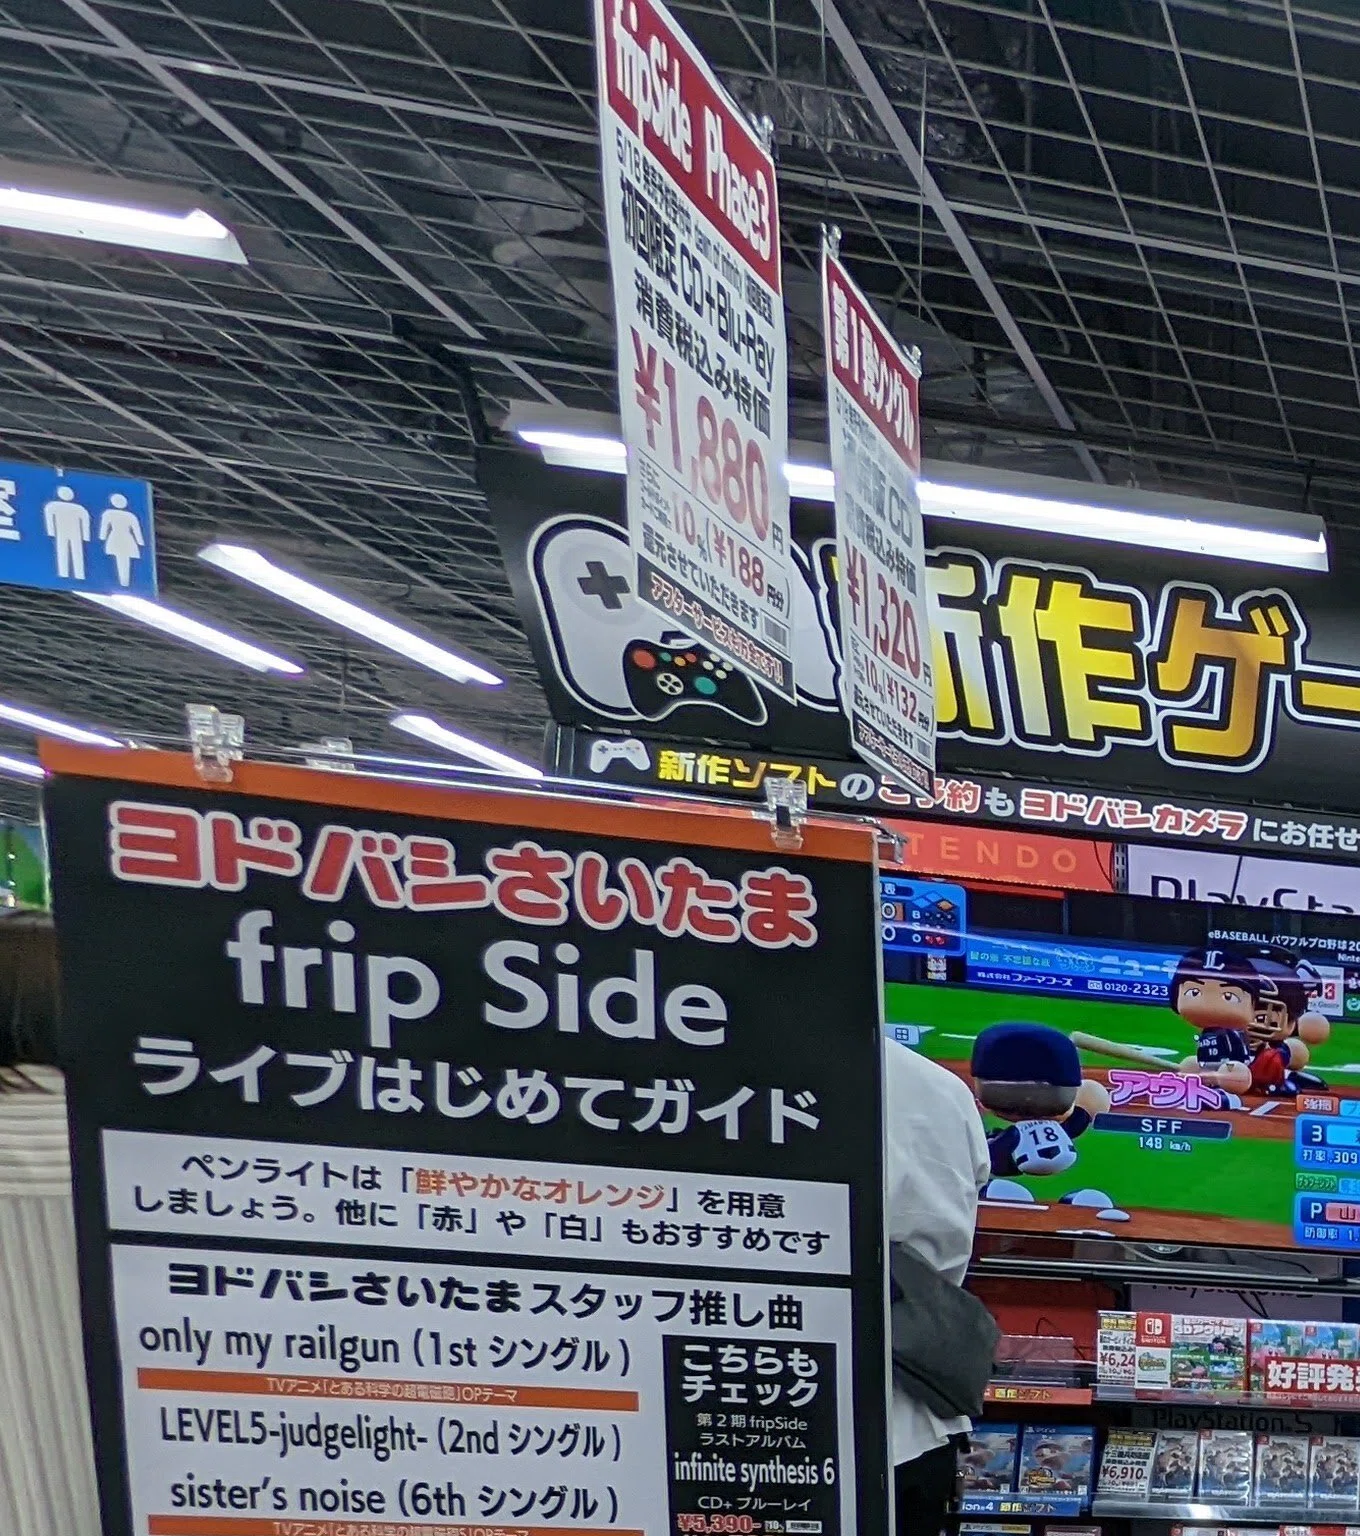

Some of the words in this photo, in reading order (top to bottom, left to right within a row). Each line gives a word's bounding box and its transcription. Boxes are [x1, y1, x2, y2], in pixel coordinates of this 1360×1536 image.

[109, 802, 819, 950] ヨドバシさいたま
[1208, 931, 1269, 944] eBASEBALL
[226, 910, 441, 1048] frip
[484, 939, 728, 1046] Side
[132, 1036, 821, 1144] ライブはじめてガイド
[1108, 1069, 1221, 1112] アウト
[1139, 1137, 1162, 1150] 148
[1141, 1119, 1183, 1134] SFF
[181, 1151, 786, 1222] ペンライトは「鮮やかなオレンジ」を用意
[135, 1184, 831, 1257] しましょう。他に「赤」や「白」もおすすめです
[168, 1262, 803, 1332] ヨドバシさいたまスタッフ推し曲
[139, 1316, 213, 1367] only
[225, 1332, 272, 1367] my
[284, 1326, 399, 1375] railgun
[414, 1328, 477, 1374] (1st
[681, 1344, 819, 1378] こちらも
[681, 1376, 819, 1408] チェック
[160, 1407, 427, 1461] LEVEL5-judgelight-
[439, 1416, 498, 1454] (2nd
[700, 1433, 806, 1449] ラストアルバム
[750, 1415, 808, 1431] fripSide
[674, 1452, 736, 1484] infinite
[740, 1456, 819, 1492] synthesis
[823, 1457, 835, 1486] 6
[301, 1479, 386, 1516] noise
[399, 1478, 465, 1519] (6th
